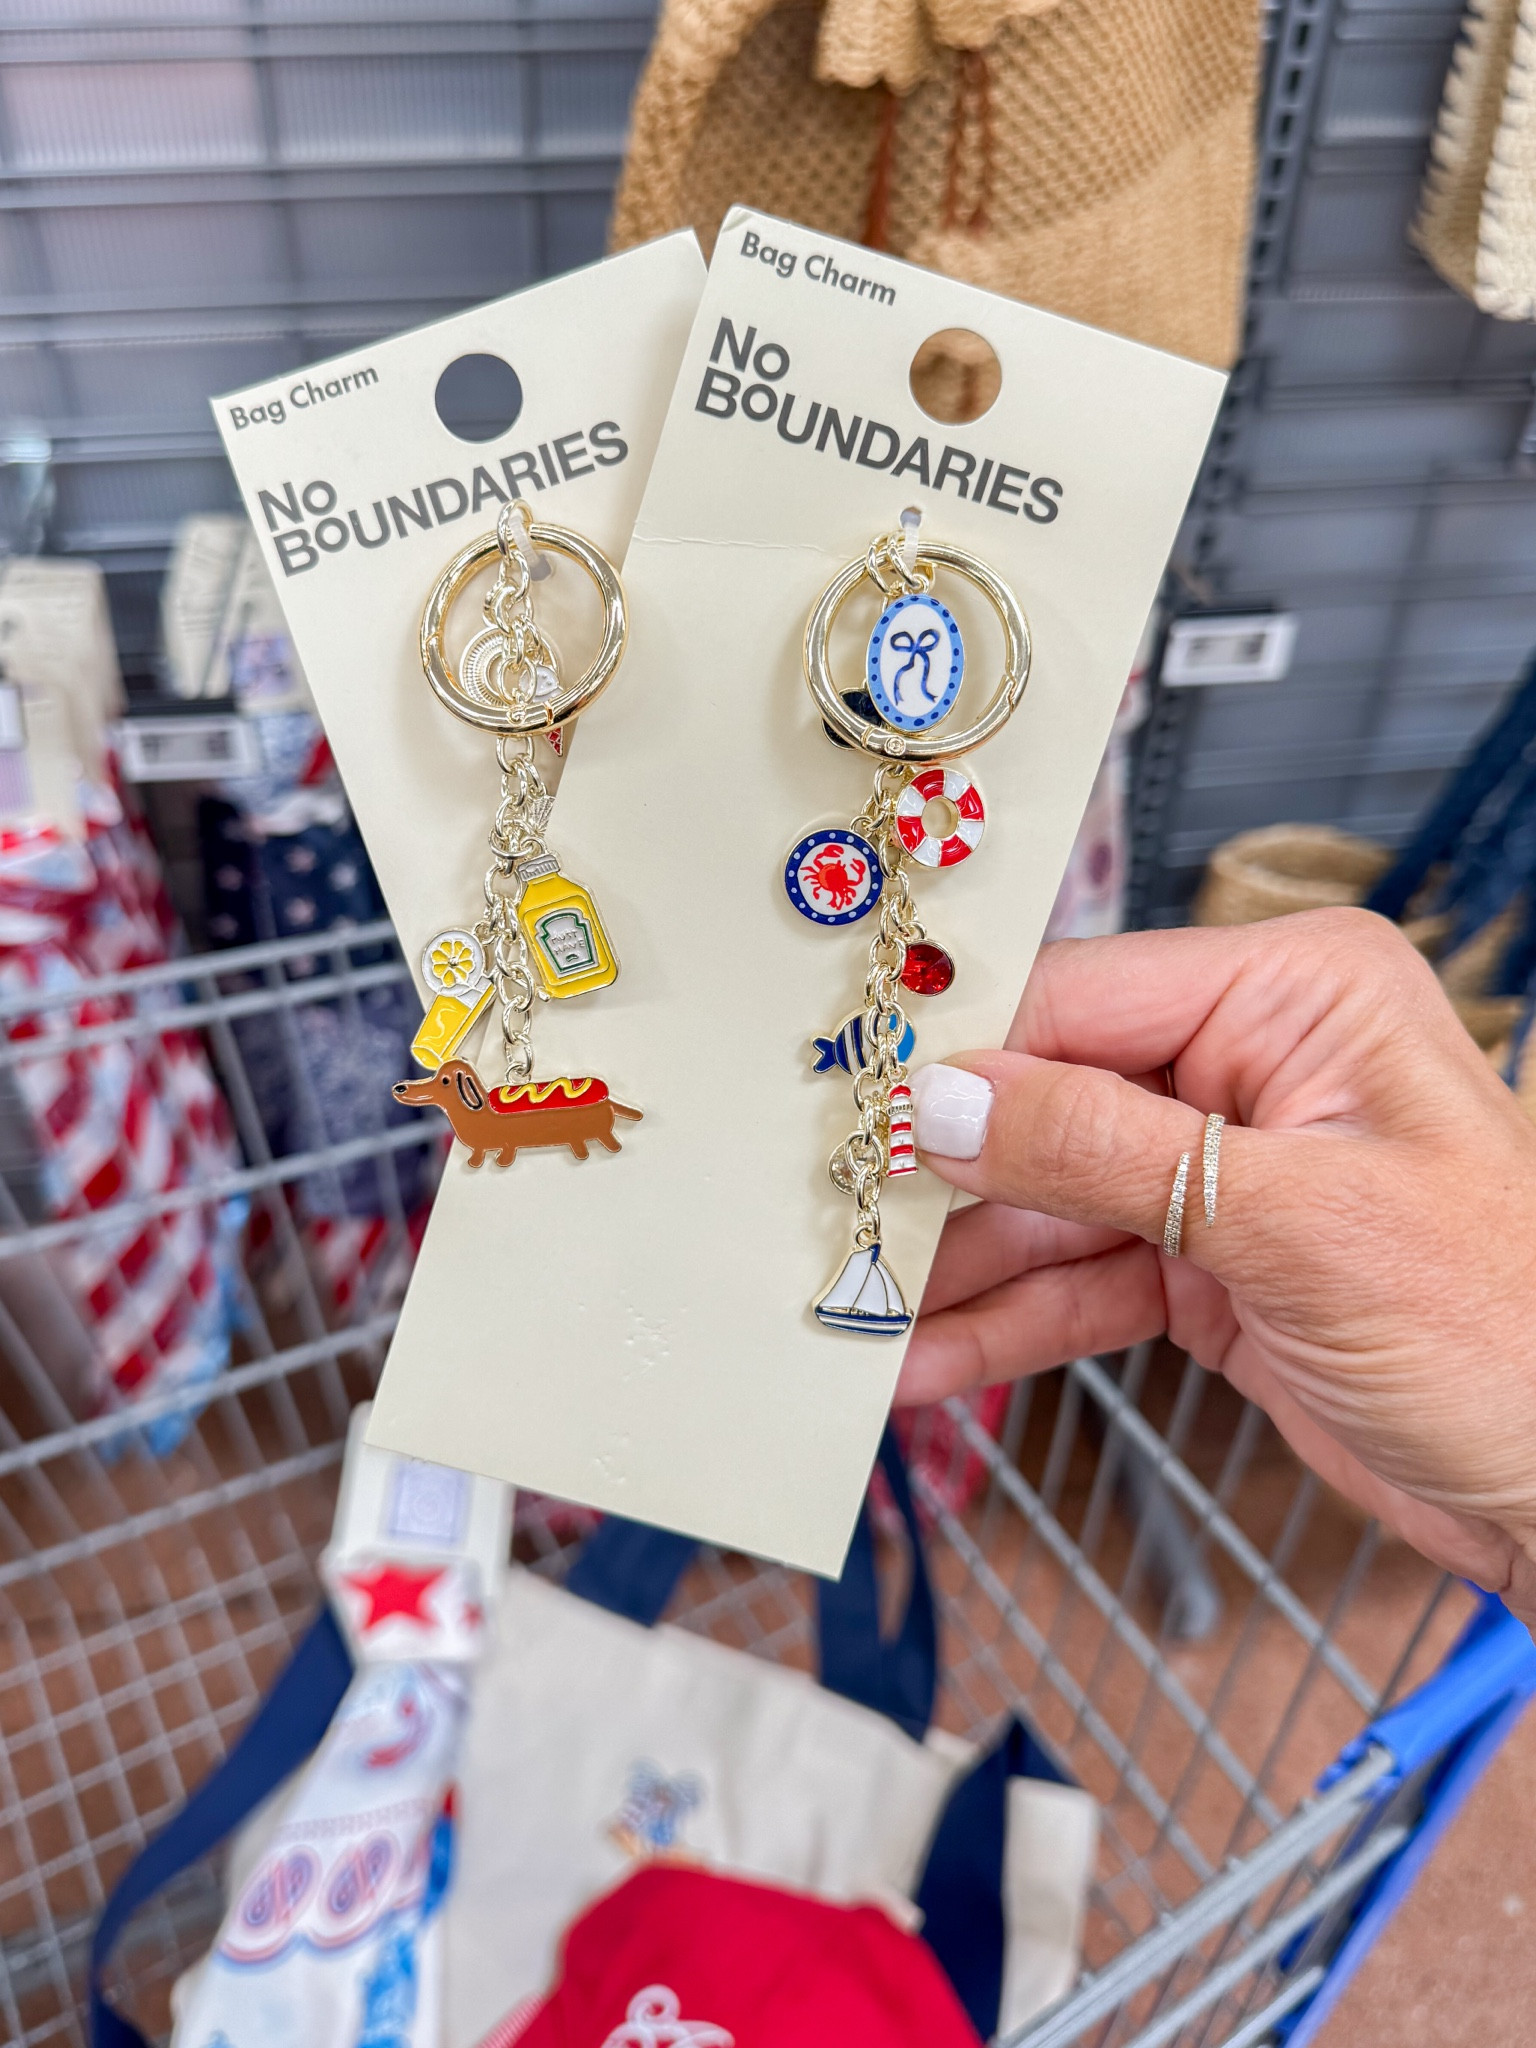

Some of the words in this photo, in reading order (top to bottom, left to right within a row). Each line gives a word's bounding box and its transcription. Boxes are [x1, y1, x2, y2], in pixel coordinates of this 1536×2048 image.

[740, 231, 797, 278] Bag
[804, 254, 897, 306] Charm
[230, 398, 287, 430] Bag
[289, 364, 379, 409] Charm
[695, 366, 1064, 525] BOUNDARIES
[273, 420, 629, 578] BOUNDARIES
[551, 930, 578, 945] MUST
[555, 939, 586, 955] HAVE
